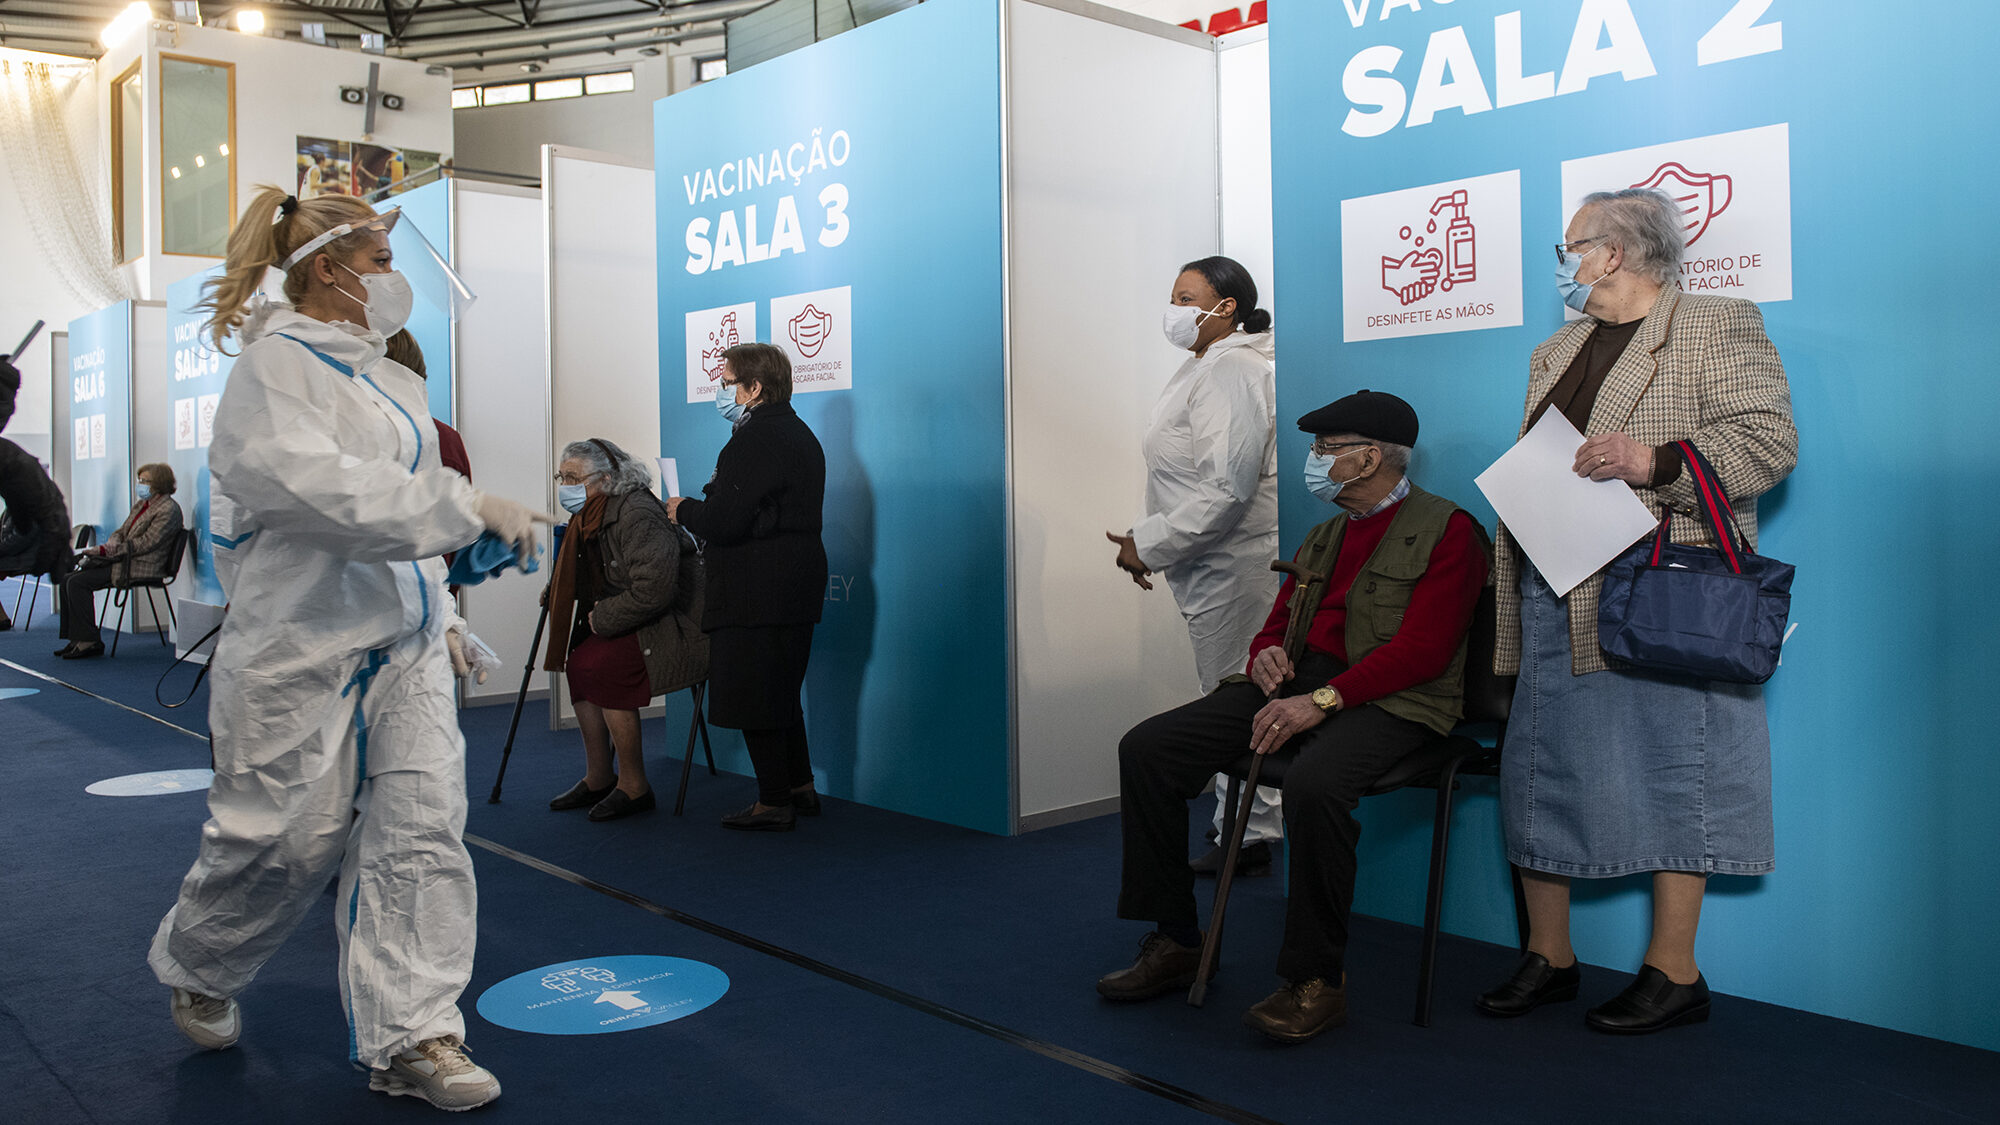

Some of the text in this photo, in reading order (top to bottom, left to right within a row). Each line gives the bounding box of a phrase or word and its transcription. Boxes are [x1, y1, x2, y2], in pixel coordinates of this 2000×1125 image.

[1341, 0, 1784, 138] SALA 2
[683, 127, 850, 206] VACINAÇÃO
[685, 183, 850, 275] SALA 3
[1739, 254, 1761, 269] DE
[1689, 274, 1745, 291] FACIAL
[1367, 303, 1495, 328] DESINFETE AS MÃOS
[175, 345, 208, 382] SALA
[793, 360, 842, 374] OBRIGATÓRIO DE
[816, 372, 836, 382] FACIAL
[74, 370, 105, 403] SALA 6
[527, 990, 600, 1010] MANTENHA
[599, 1011, 641, 1026] OEIRAS
[653, 997, 693, 1011] VALLEY
